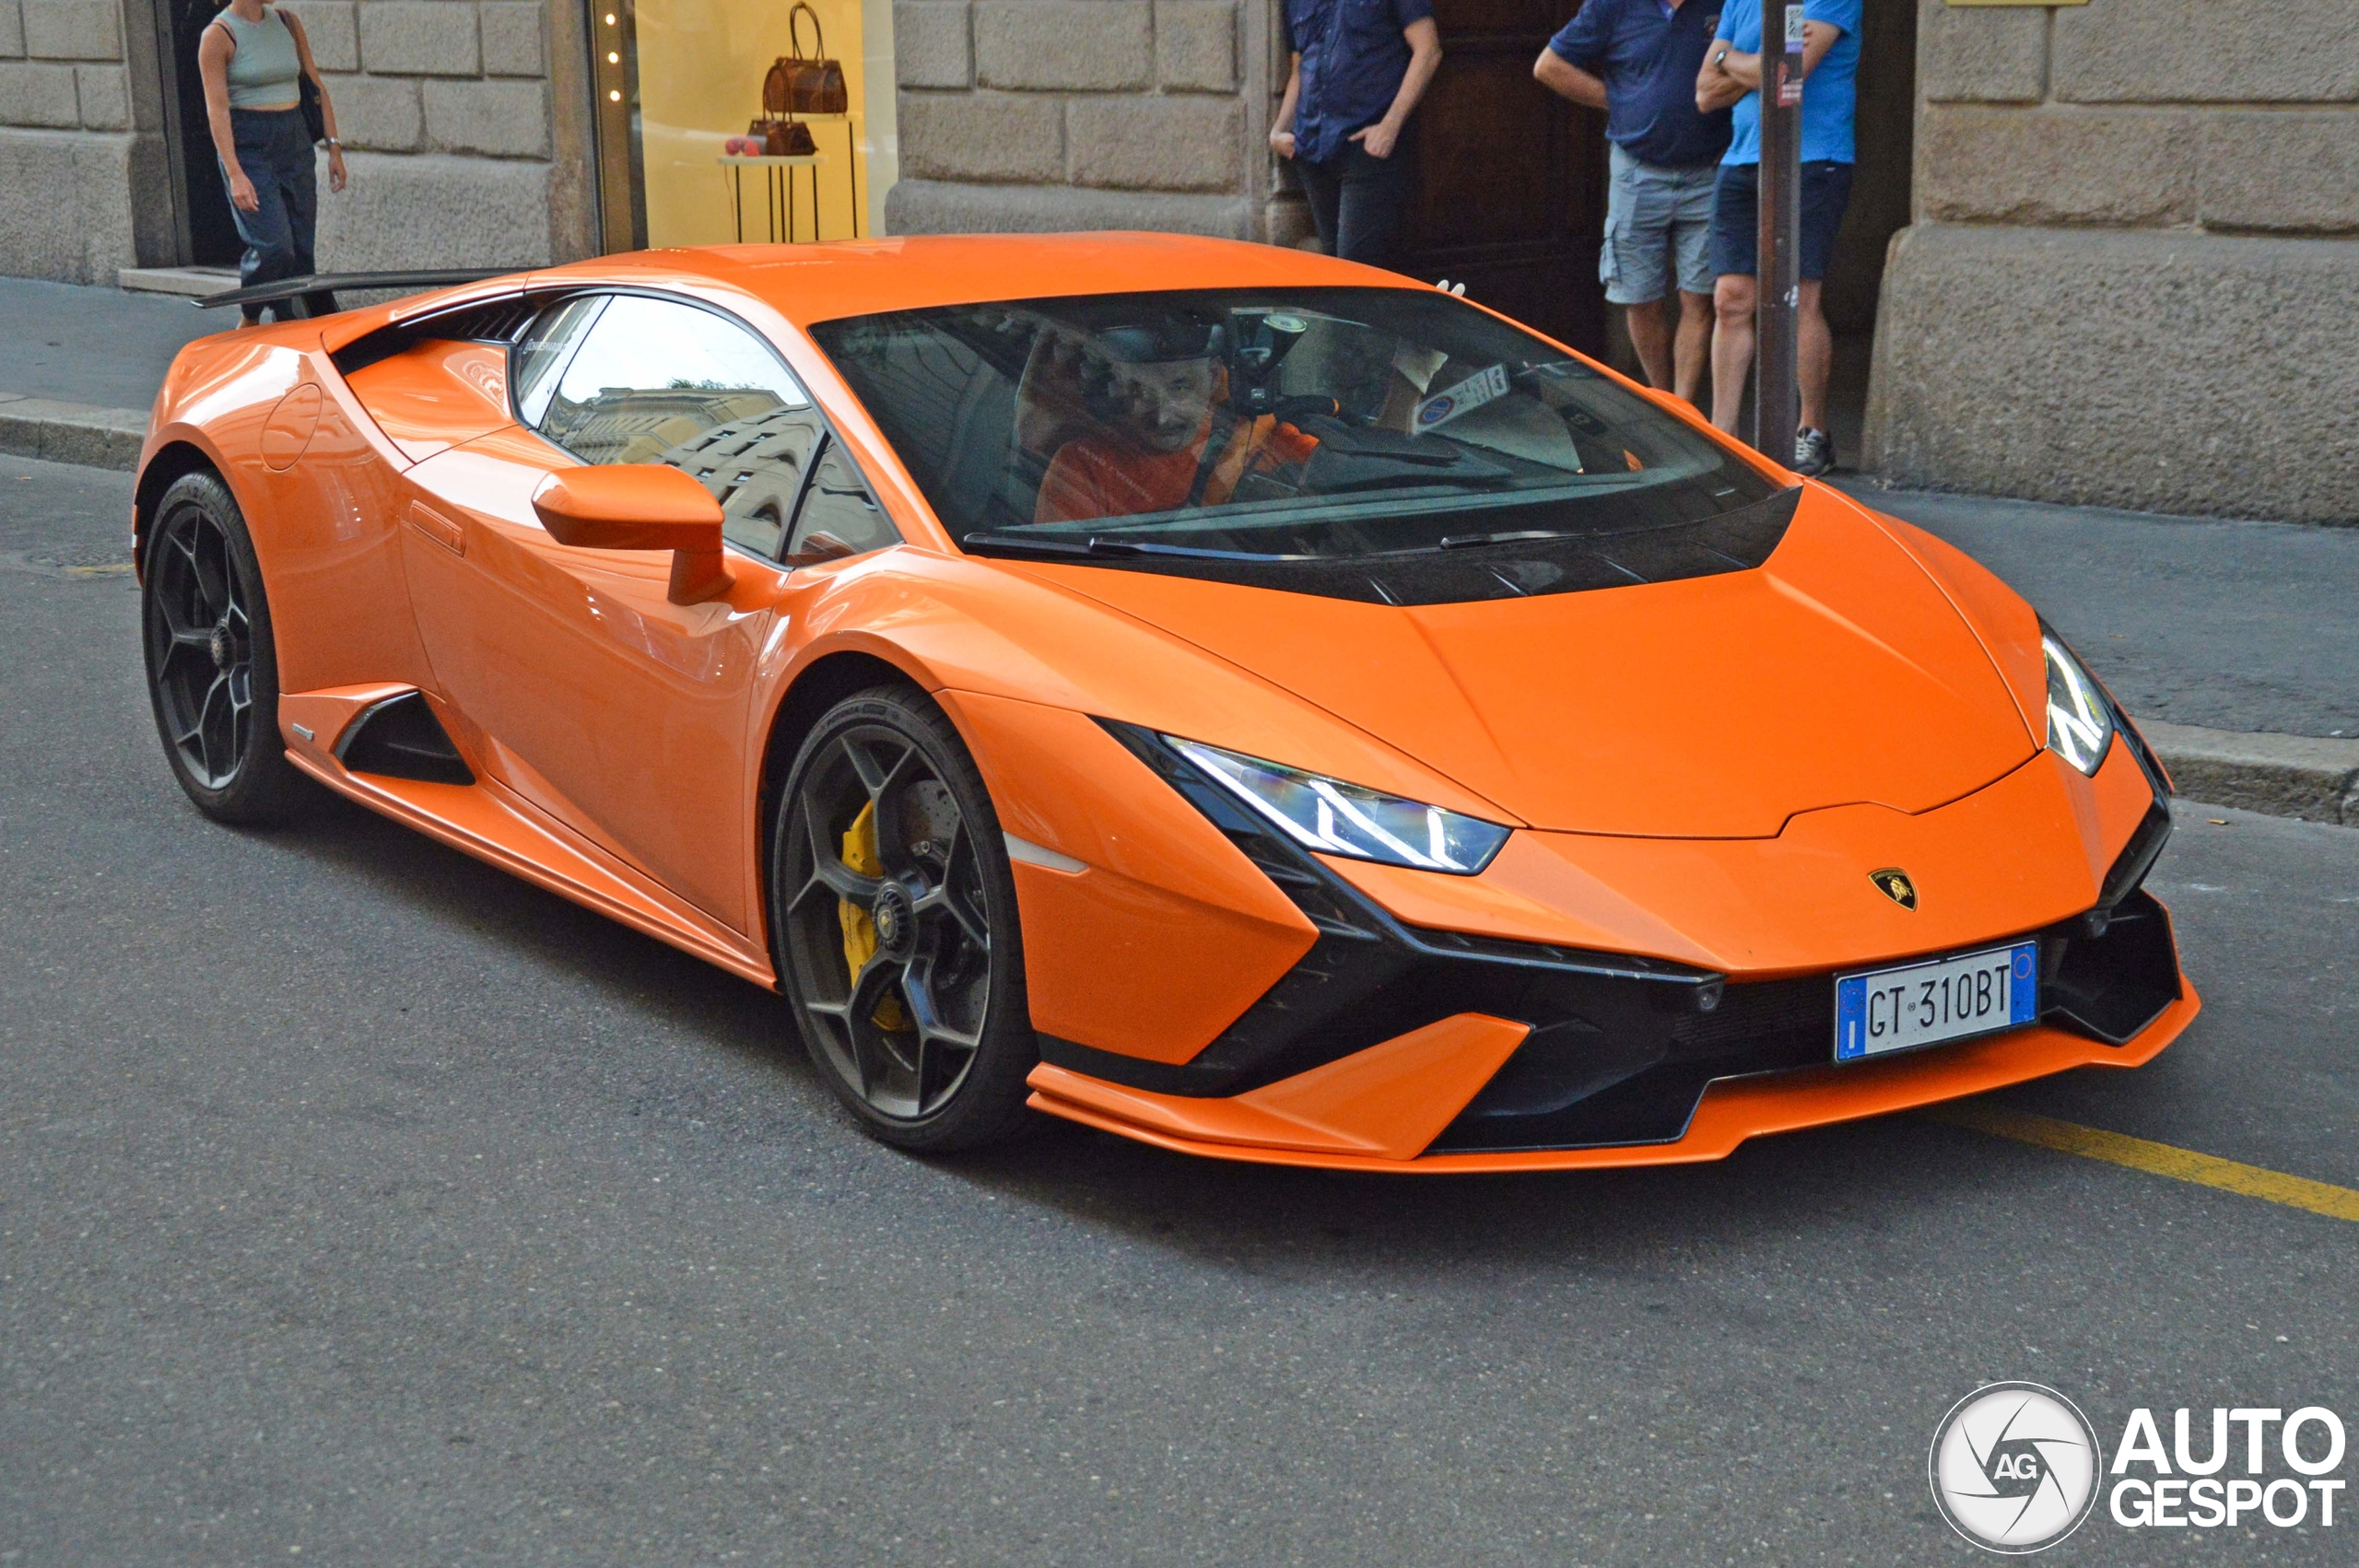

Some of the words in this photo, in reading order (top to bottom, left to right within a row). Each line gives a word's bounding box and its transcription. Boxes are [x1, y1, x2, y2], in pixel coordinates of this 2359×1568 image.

[1869, 986, 1906, 1037] GT
[1919, 965, 2011, 1028] 310BT
[1848, 1020, 1856, 1049] I
